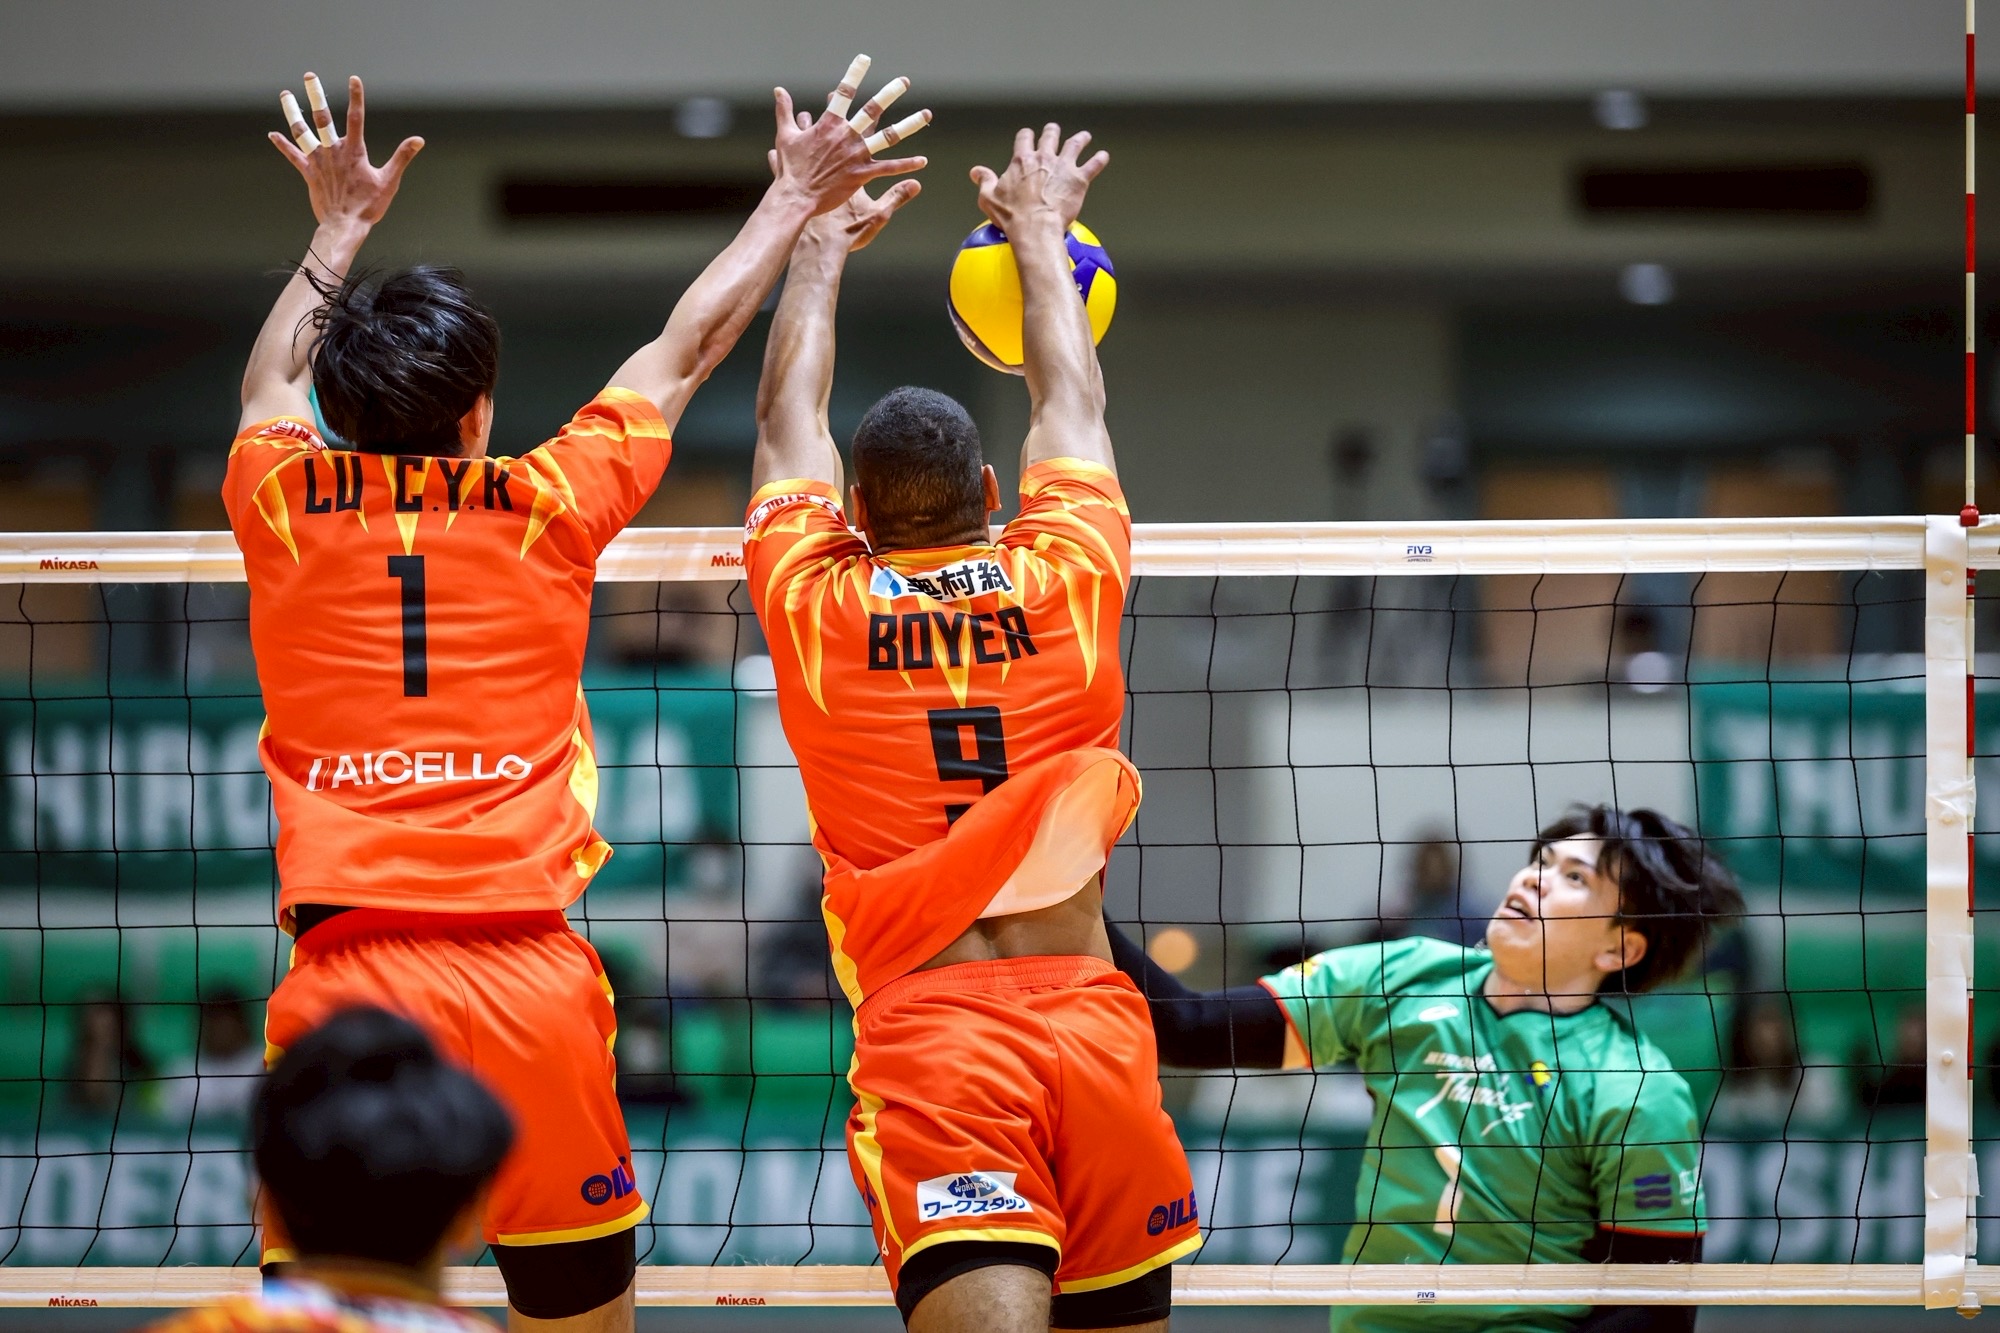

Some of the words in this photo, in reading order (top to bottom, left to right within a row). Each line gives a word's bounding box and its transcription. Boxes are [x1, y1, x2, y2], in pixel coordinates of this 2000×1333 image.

[387, 554, 428, 697] 1
[867, 605, 1039, 671] BOYER
[331, 749, 533, 790] AICELLO
[927, 705, 1009, 829] 9
